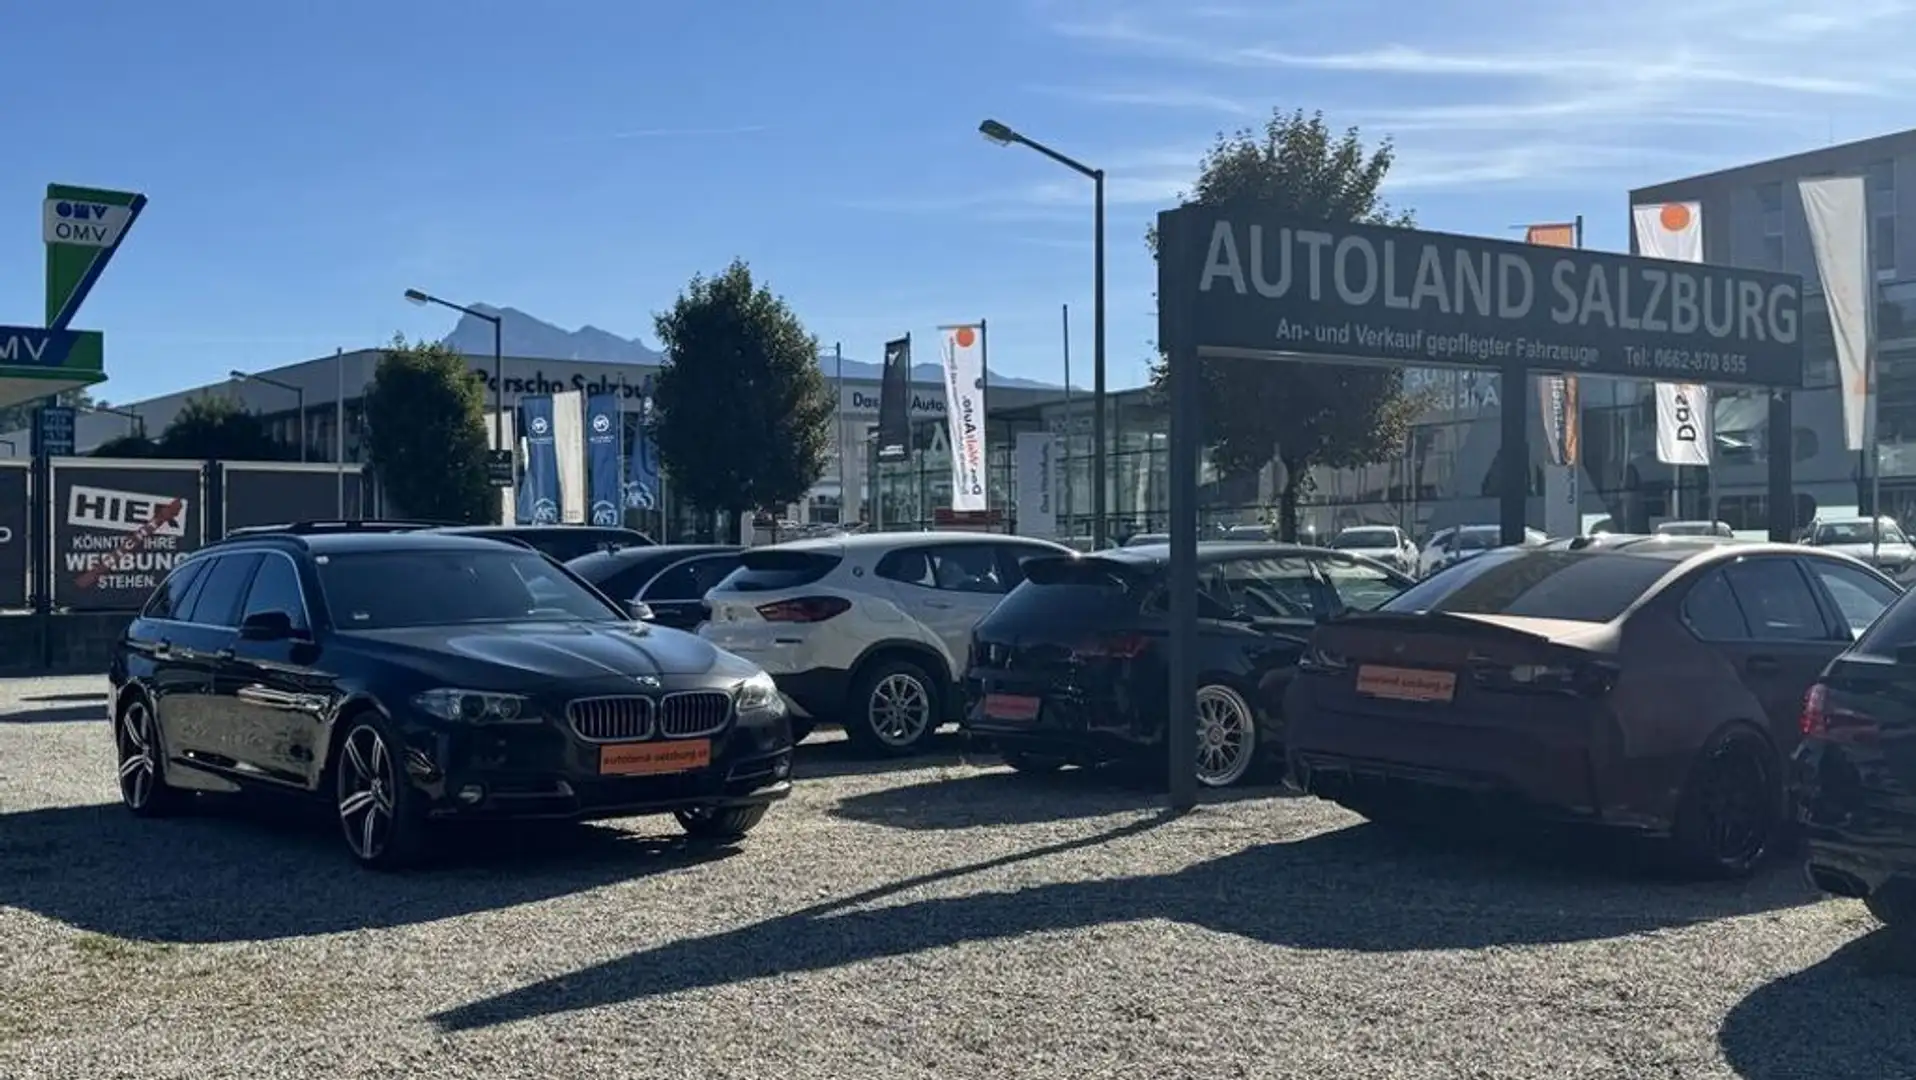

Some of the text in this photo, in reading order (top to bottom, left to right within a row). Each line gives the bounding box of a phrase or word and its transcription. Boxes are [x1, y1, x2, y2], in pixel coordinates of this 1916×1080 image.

[56, 222, 108, 242] OMV
[1199, 220, 1797, 344] AUTOLAND SALZBURG
[1276, 318, 1310, 340] An-
[1315, 323, 1349, 345] und
[1355, 324, 1423, 349] Verkauf
[1427, 331, 1511, 360] gepflegter
[1515, 337, 1599, 365] Fahrzeuge
[1723, 353, 1747, 373] 855
[144, 536, 176, 550] IHRE
